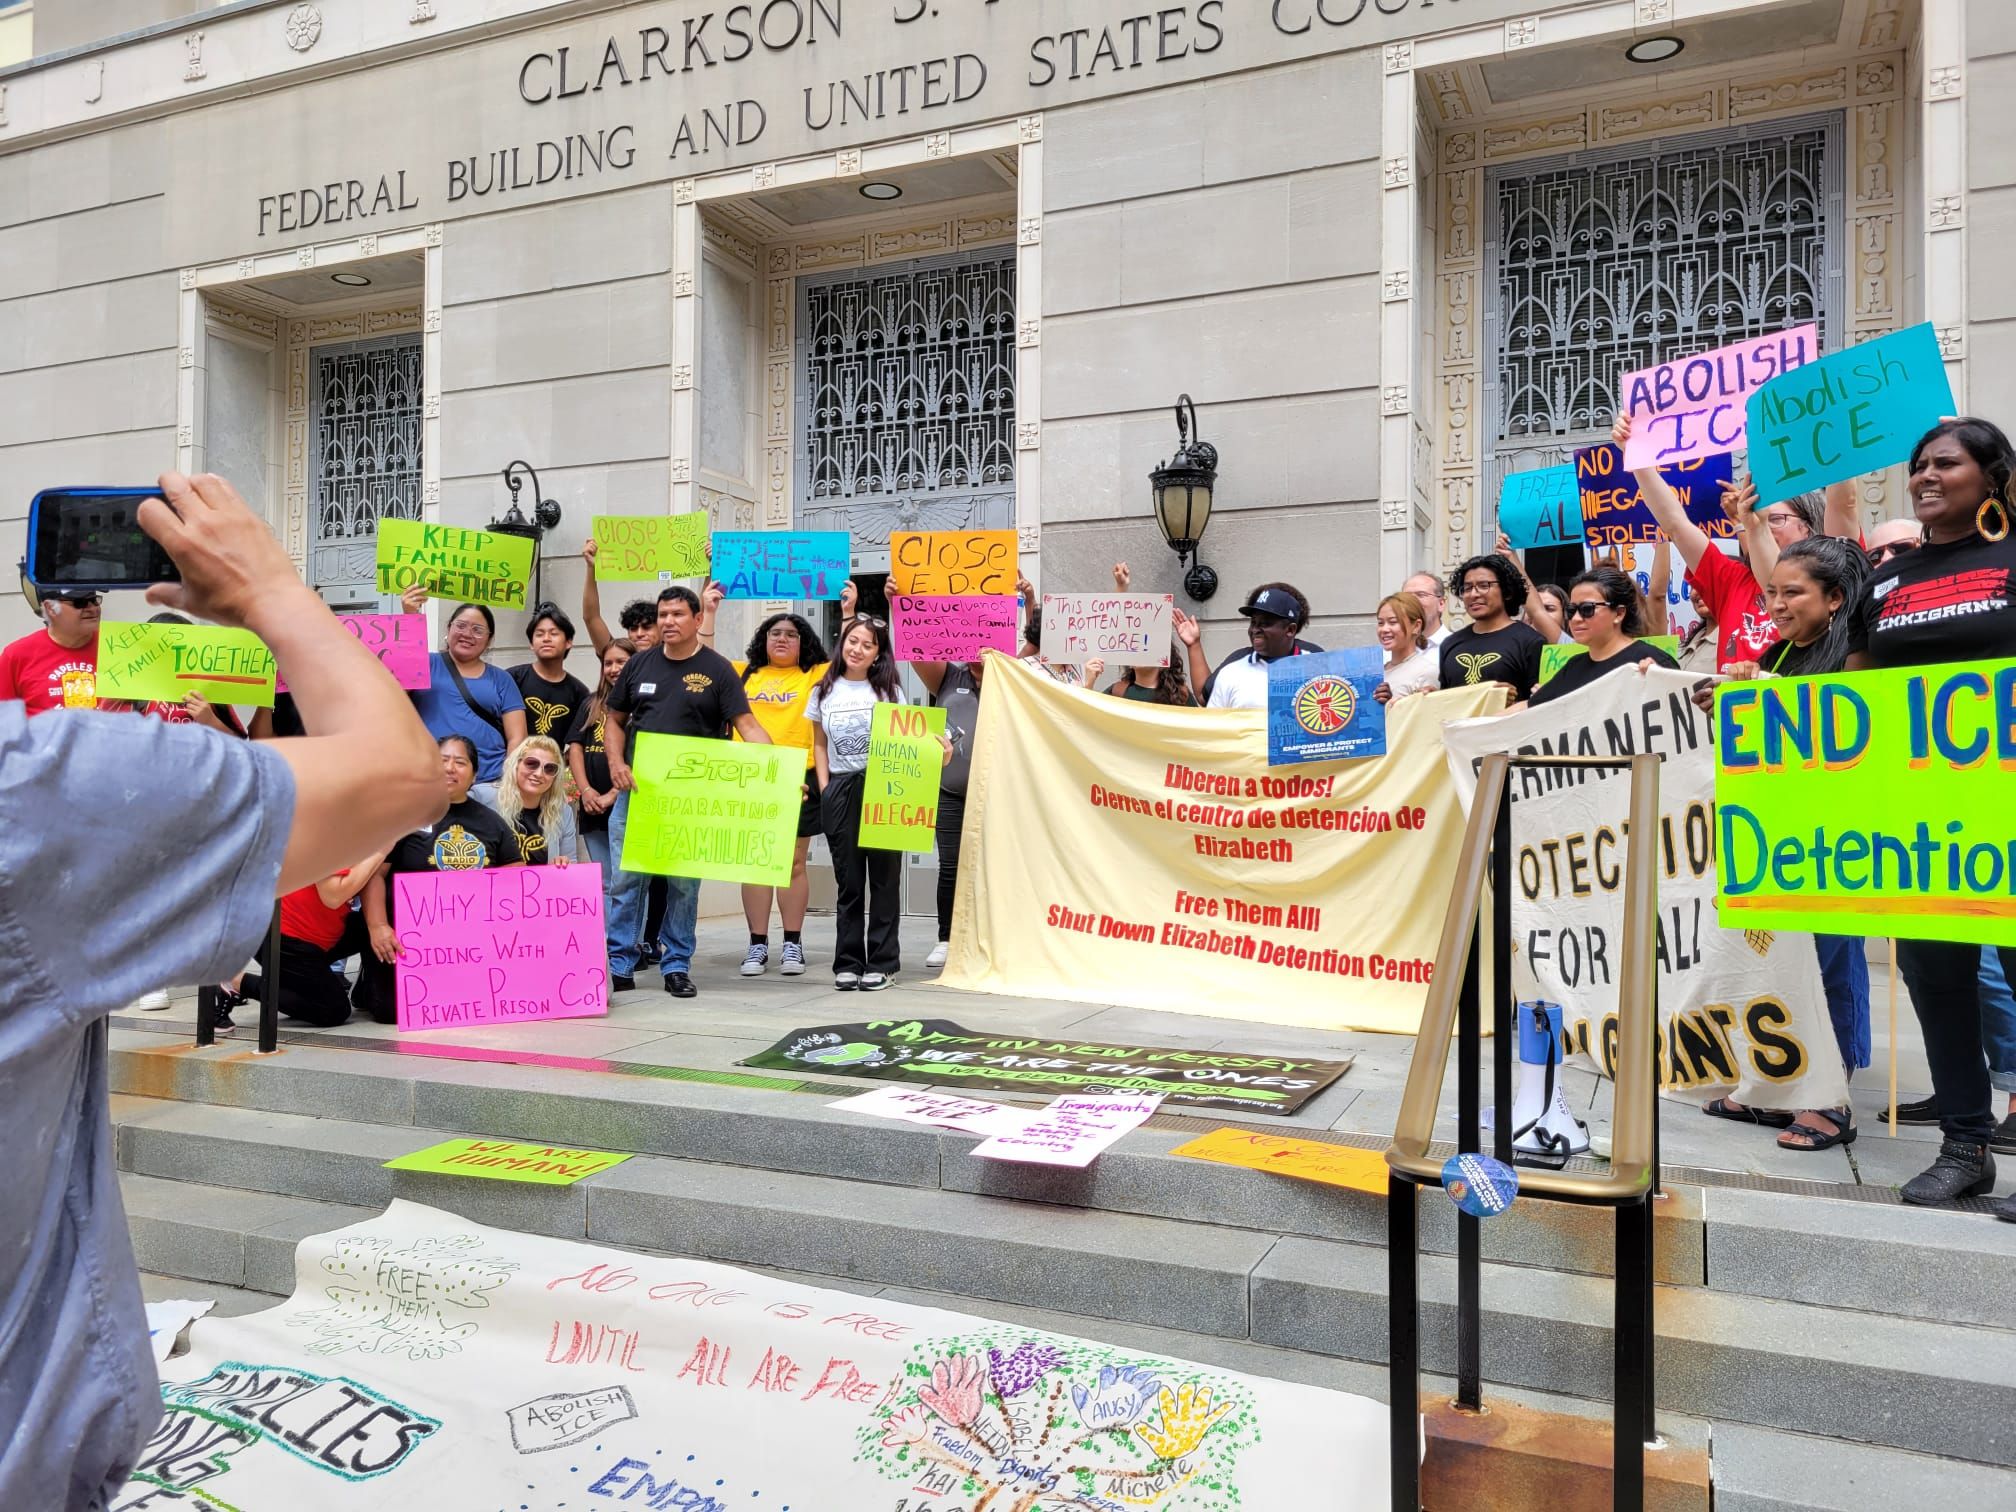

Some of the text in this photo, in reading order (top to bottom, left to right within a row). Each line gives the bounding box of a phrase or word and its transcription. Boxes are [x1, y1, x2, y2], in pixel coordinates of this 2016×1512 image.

[519, 0, 842, 105] CLARKSON
[257, 170, 420, 237] FEDERAL
[448, 124, 635, 202] BUILDING
[669, 99, 767, 159] AND
[803, 53, 988, 131] UNITED
[1028, 0, 1225, 87] STATES
[1629, 336, 1805, 418] ABOLISH
[1761, 350, 1910, 434] Abolish
[1647, 403, 1747, 461] IC
[1577, 447, 1613, 479] NO
[1519, 471, 1575, 503] FREE
[424, 524, 494, 552] KEEP
[1699, 518, 1736, 539] AND
[394, 545, 512, 578] FAMILIES
[377, 562, 525, 606] TOGETHER
[1054, 597, 1082, 614] This
[1067, 614, 1118, 630] ROTTEN
[1125, 615, 1142, 629] TO
[104, 622, 152, 655] KEEP
[48, 662, 93, 681] PAPELES
[106, 627, 186, 687] FAMILIES
[172, 644, 276, 675] TOGETHER
[889, 708, 928, 738] NO
[1720, 681, 1872, 774] END
[869, 738, 919, 761] HUMAN
[882, 759, 922, 778] BEING
[1164, 762, 1335, 799] Liberen a todos!
[886, 780, 905, 796] IS
[863, 801, 937, 829] ILLEGAL
[1154, 799, 1173, 820] el
[1176, 803, 1244, 828] centro
[1248, 807, 1276, 829] de
[1280, 805, 1392, 833] detencion
[1395, 805, 1426, 831] de
[447, 856, 476, 864] RADIO
[655, 823, 776, 867] FAMILIES
[1193, 834, 1293, 863] Elizabeth
[1718, 804, 2016, 896] Detentio
[1174, 889, 1219, 917] Free
[1223, 896, 1283, 928] Them
[564, 931, 580, 955] A
[1047, 903, 1435, 985] Shut Down Elizabeth Detention Cente
[1527, 925, 1610, 988] FOR
[984, 1055, 1081, 1068] ARE
[1086, 1062, 1176, 1076] THE
[1183, 1068, 1319, 1089] ONES
[1043, 1043, 1143, 1058] NEW
[1146, 1051, 1316, 1073] JERSEY
[1053, 1099, 1152, 1113] Immigrants
[466, 1141, 516, 1153] WE
[440, 1153, 609, 1178] HUMAN!
[377, 1258, 432, 1300] FREE
[386, 1293, 430, 1320] THEM
[546, 1263, 639, 1292] NO
[649, 1281, 750, 1307] ONE
[821, 1312, 914, 1341] FREE
[545, 1320, 645, 1371] UNTIL
[747, 1345, 803, 1392] ARE
[527, 1392, 623, 1427] ABOLISH
[553, 1408, 608, 1441] ICE
[932, 1425, 984, 1473] Freedom
[1105, 1459, 1194, 1498] Michelle
